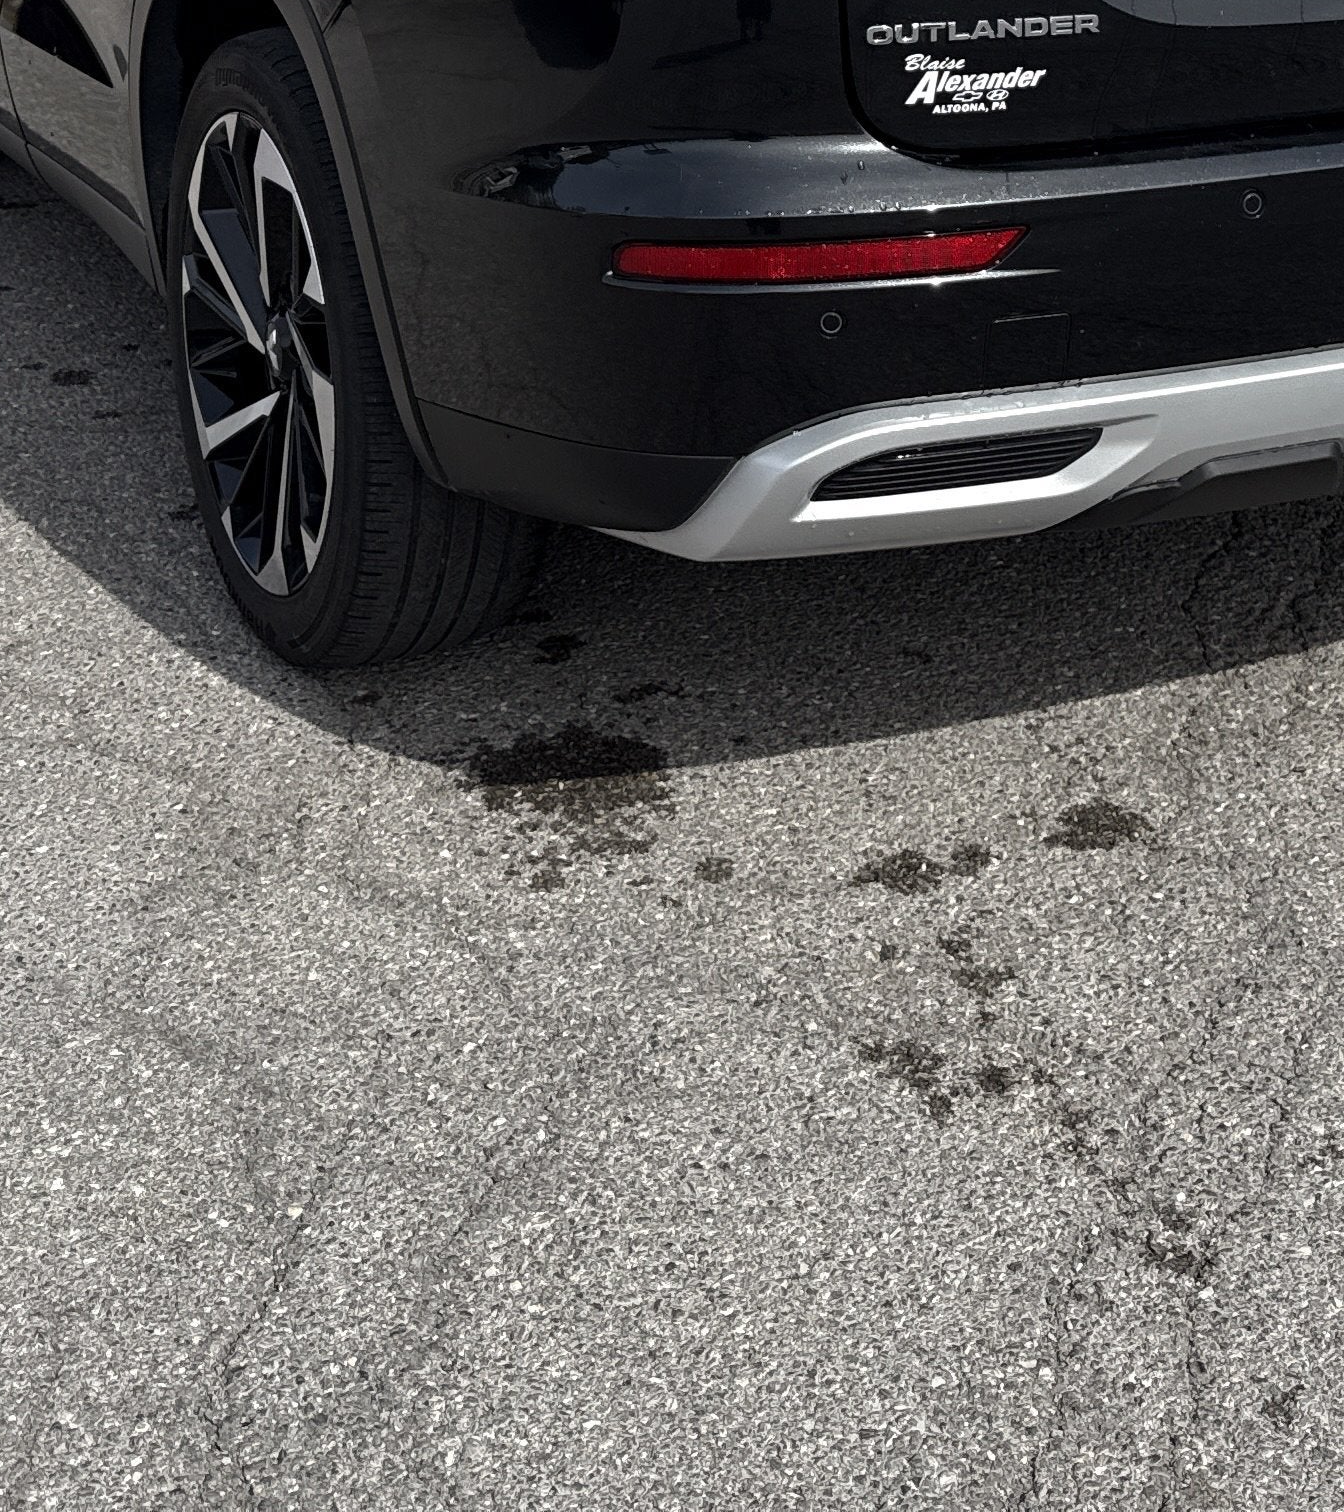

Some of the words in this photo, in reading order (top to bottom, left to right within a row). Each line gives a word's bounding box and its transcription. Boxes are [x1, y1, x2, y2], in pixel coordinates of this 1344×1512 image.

[866, 14, 1100, 45] OUTLANDER
[905, 54, 966, 71] Blaise
[905, 67, 1047, 105] Alexander
[932, 102, 990, 114] ALTOONA,
[991, 101, 1007, 111] PA
